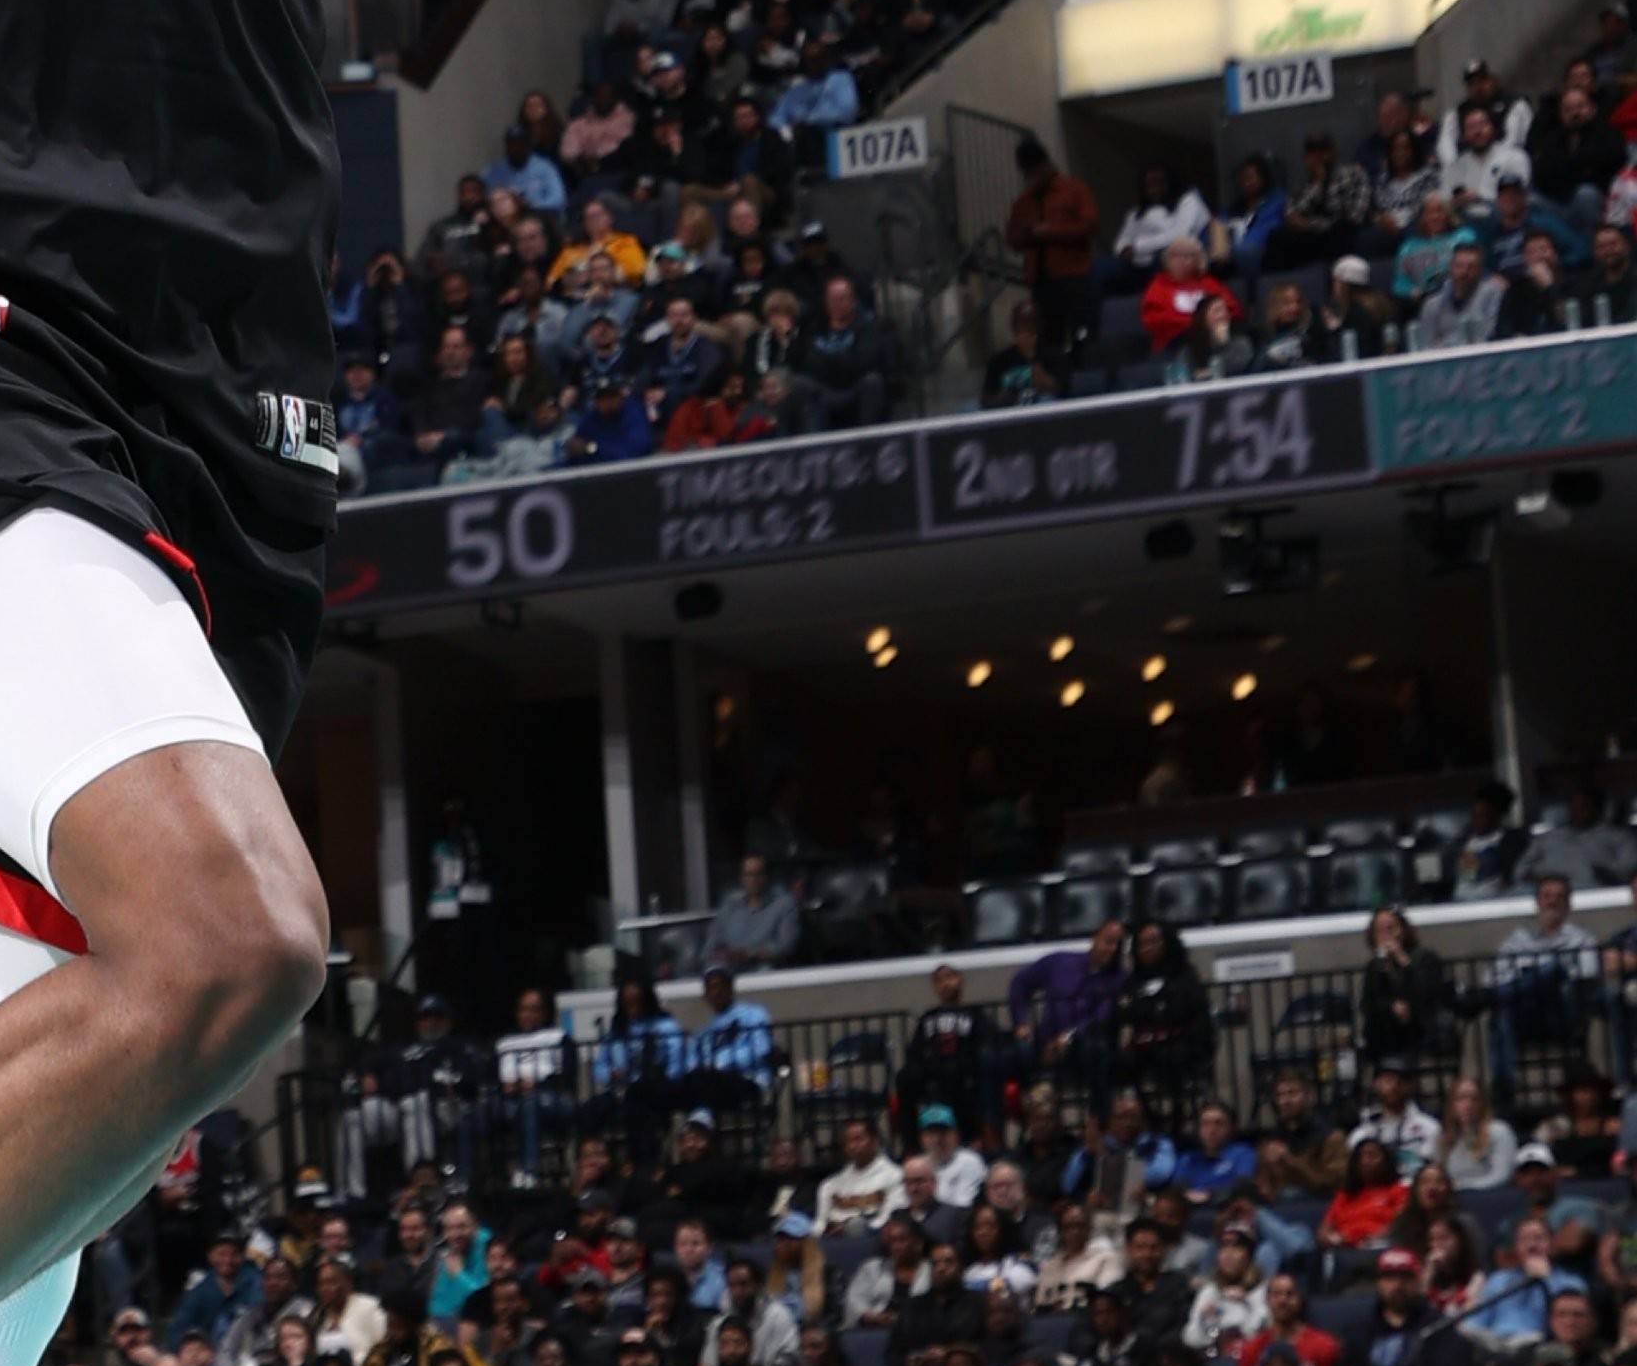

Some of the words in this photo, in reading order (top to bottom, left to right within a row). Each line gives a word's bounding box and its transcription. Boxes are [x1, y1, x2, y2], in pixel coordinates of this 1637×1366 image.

[1246, 60, 1323, 102] 107A
[846, 126, 919, 167] 107A
[1168, 387, 1314, 491] 7:54
[446, 487, 575, 587] 50
